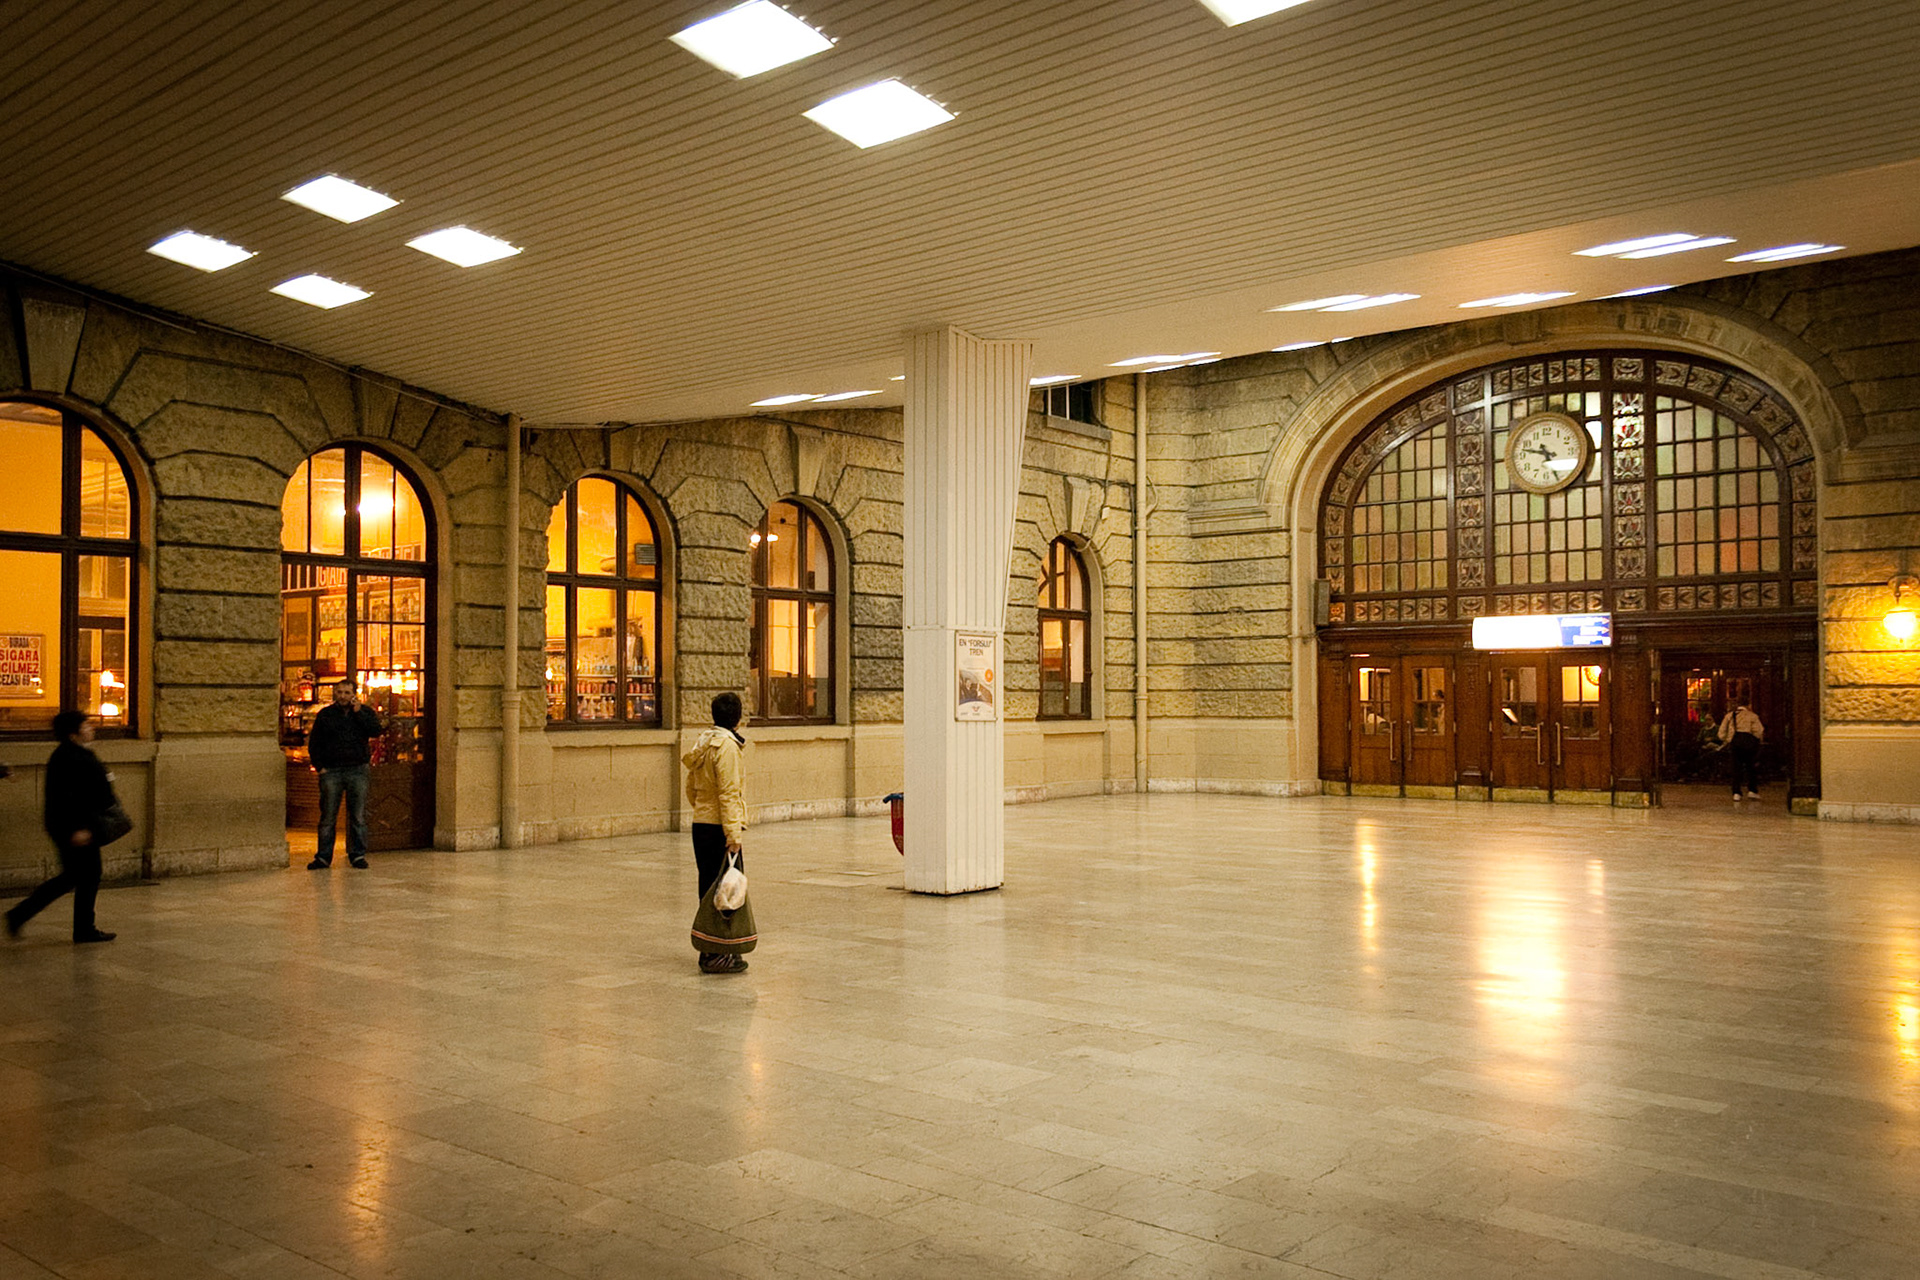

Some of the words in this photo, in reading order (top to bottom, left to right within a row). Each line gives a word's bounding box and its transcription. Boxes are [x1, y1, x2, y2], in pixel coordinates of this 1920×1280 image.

[1542, 427, 1552, 436] 12
[1533, 432, 1539, 441] 11
[1563, 436, 1570, 445] 2
[1523, 440, 1531, 449] 10
[1568, 447, 1574, 455] 3
[1519, 452, 1526, 460] 9
[1524, 462, 1531, 471] 8
[1533, 469, 1539, 478] 7
[1543, 472, 1549, 480] 6
[959, 639, 967, 647] EN
[969, 648, 984, 656] TREN
